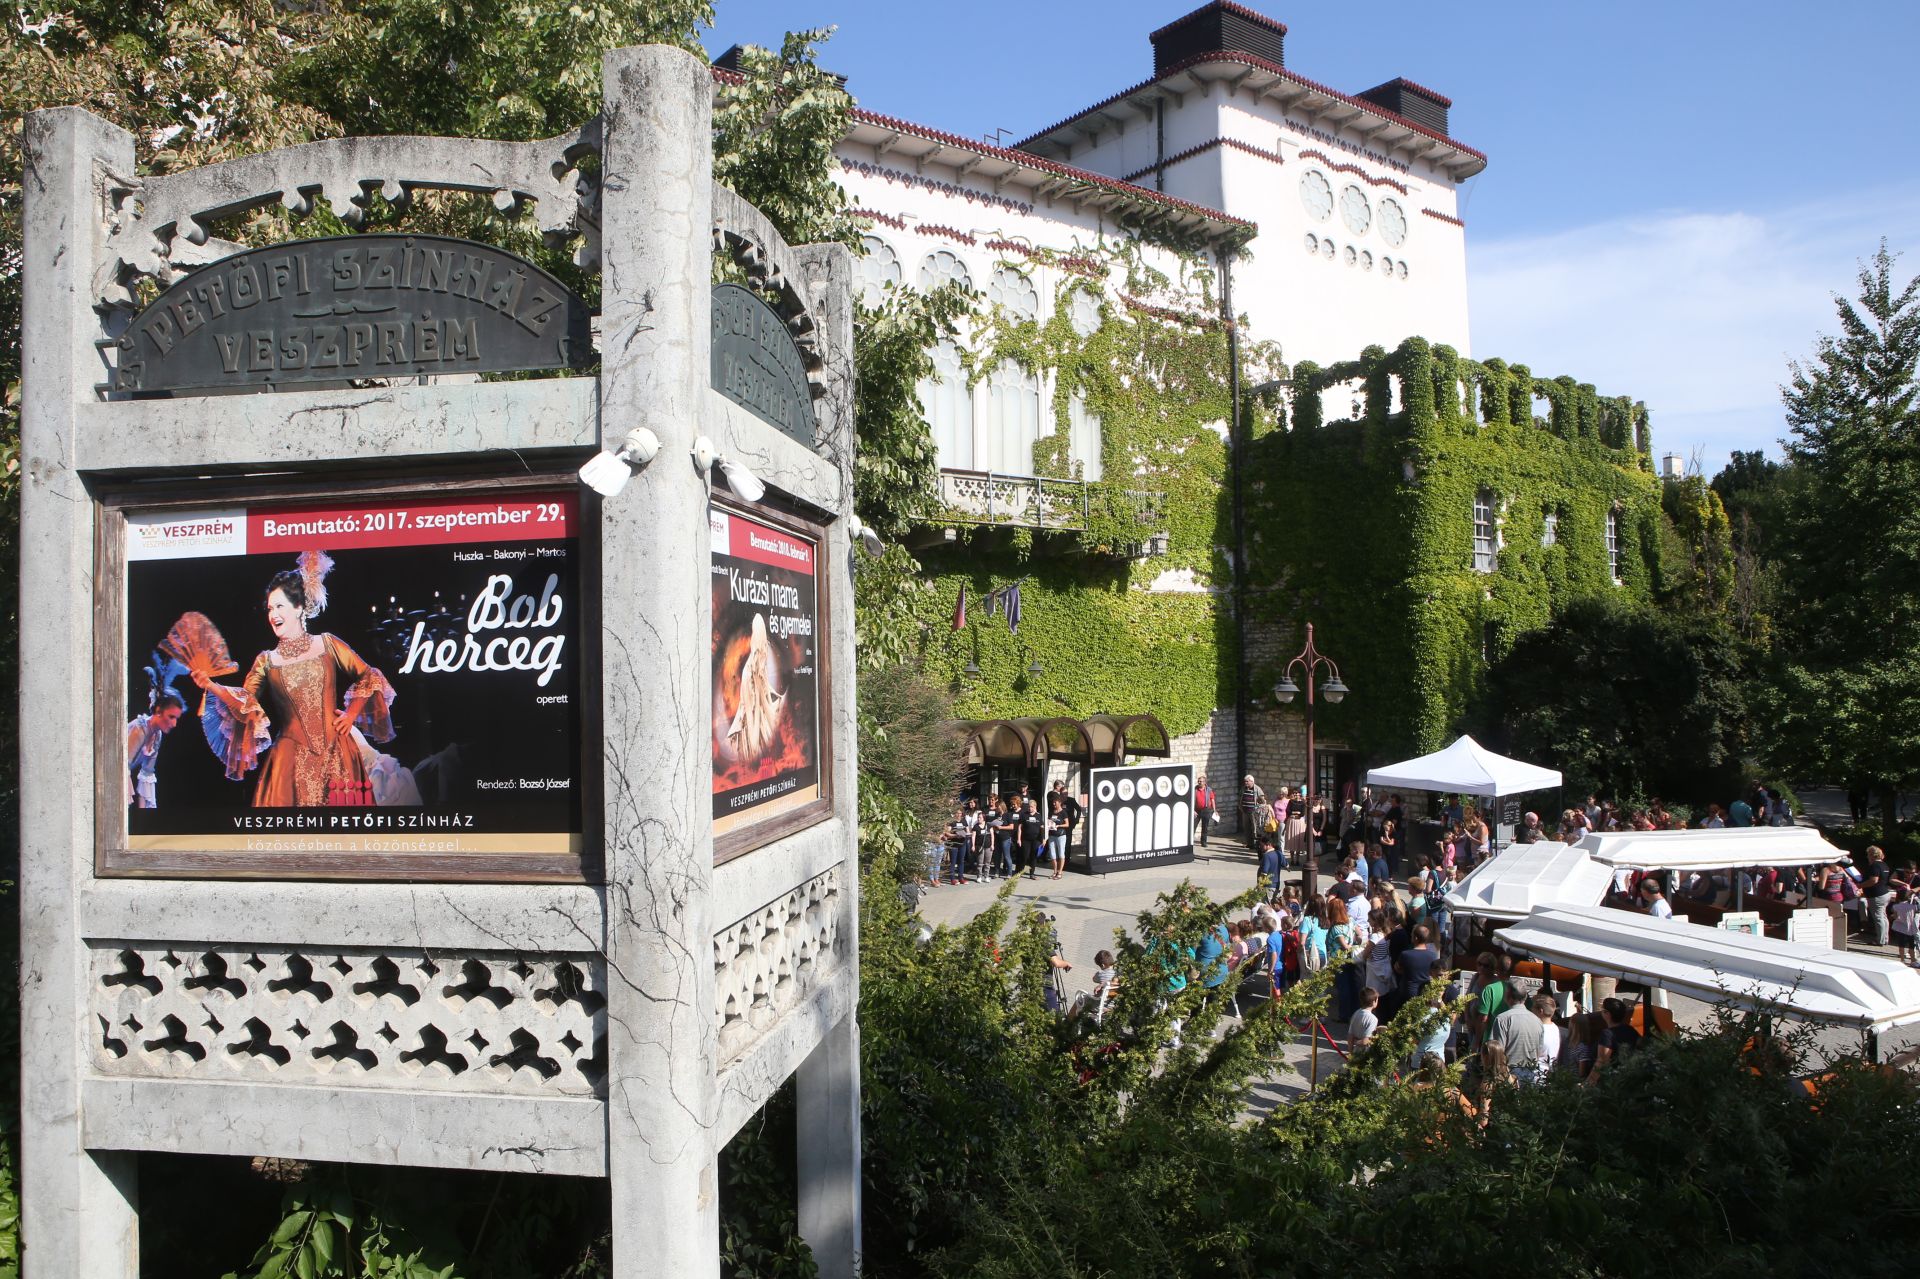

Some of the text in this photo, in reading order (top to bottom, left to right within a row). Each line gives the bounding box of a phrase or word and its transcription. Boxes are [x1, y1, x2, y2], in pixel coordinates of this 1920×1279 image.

[333, 237, 562, 337] SZÍNHÁZ
[214, 308, 480, 374] VESZPRÉM
[163, 519, 233, 538] VESZPRÉM
[263, 503, 565, 537] Bemutató: 2017. szeptember 29.
[453, 551, 484, 562] Huszka
[493, 549, 526, 561] Bakonyi
[536, 547, 566, 558] Martos
[468, 573, 563, 634] Bob
[729, 566, 799, 610] Kurázsi mama
[769, 608, 812, 640] és gyermekei
[398, 621, 566, 687] herceg
[536, 694, 568, 706] operett
[476, 777, 571, 791] Rendező: Bozsó József
[730, 776, 797, 808] VESZPRÉMI PETŐFI SZÍNHÁZ
[233, 812, 474, 828] VESZPRÉMI PETŐFI SZÍNHÁZ
[350, 841, 357, 851] a
